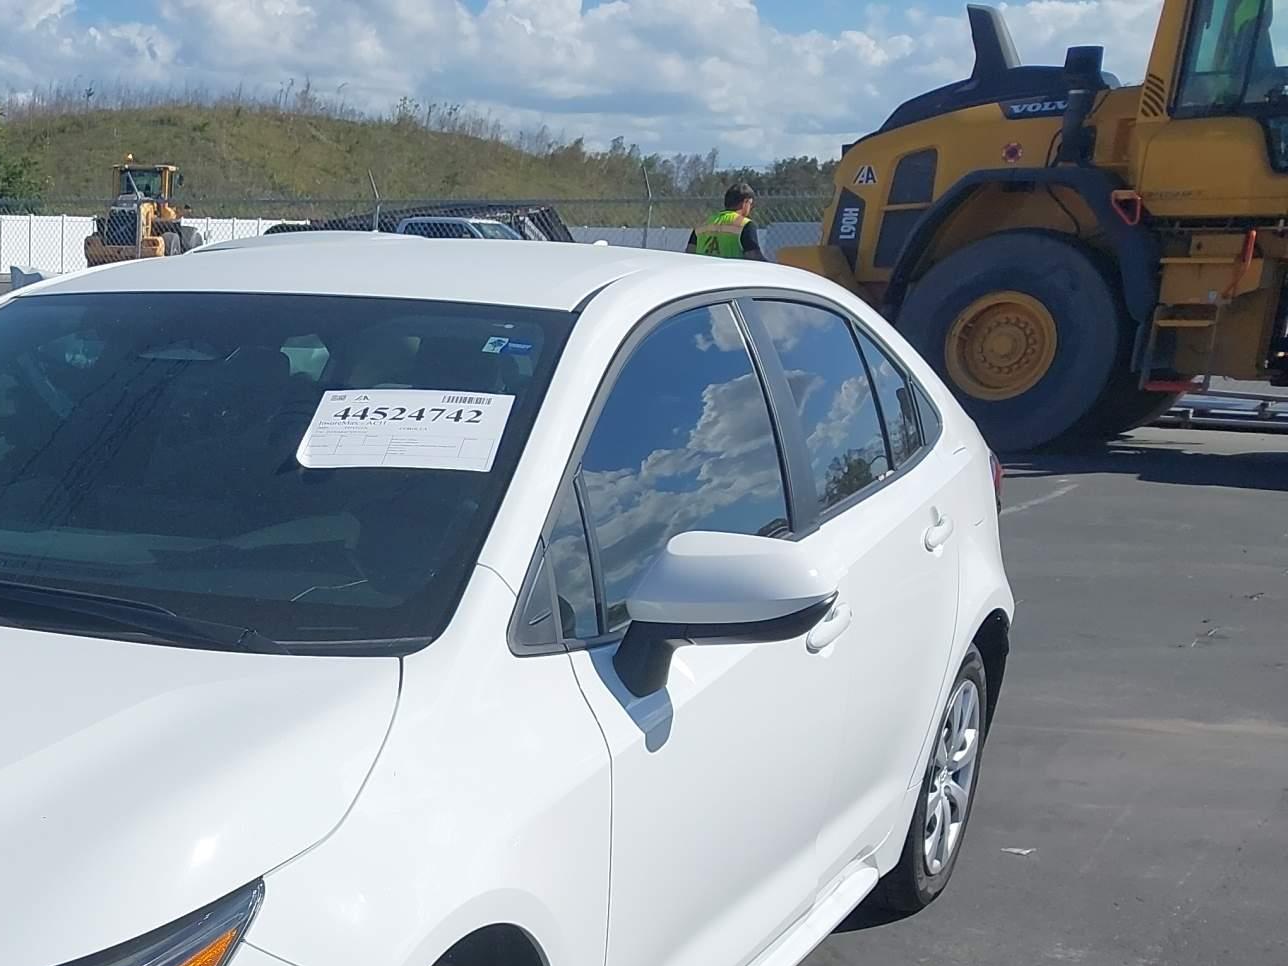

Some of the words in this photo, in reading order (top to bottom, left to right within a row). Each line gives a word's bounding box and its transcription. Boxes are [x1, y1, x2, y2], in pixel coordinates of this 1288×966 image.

[1010, 101, 1070, 114] VOLV
[839, 207, 860, 240] L90H
[333, 406, 483, 424] 44524742
